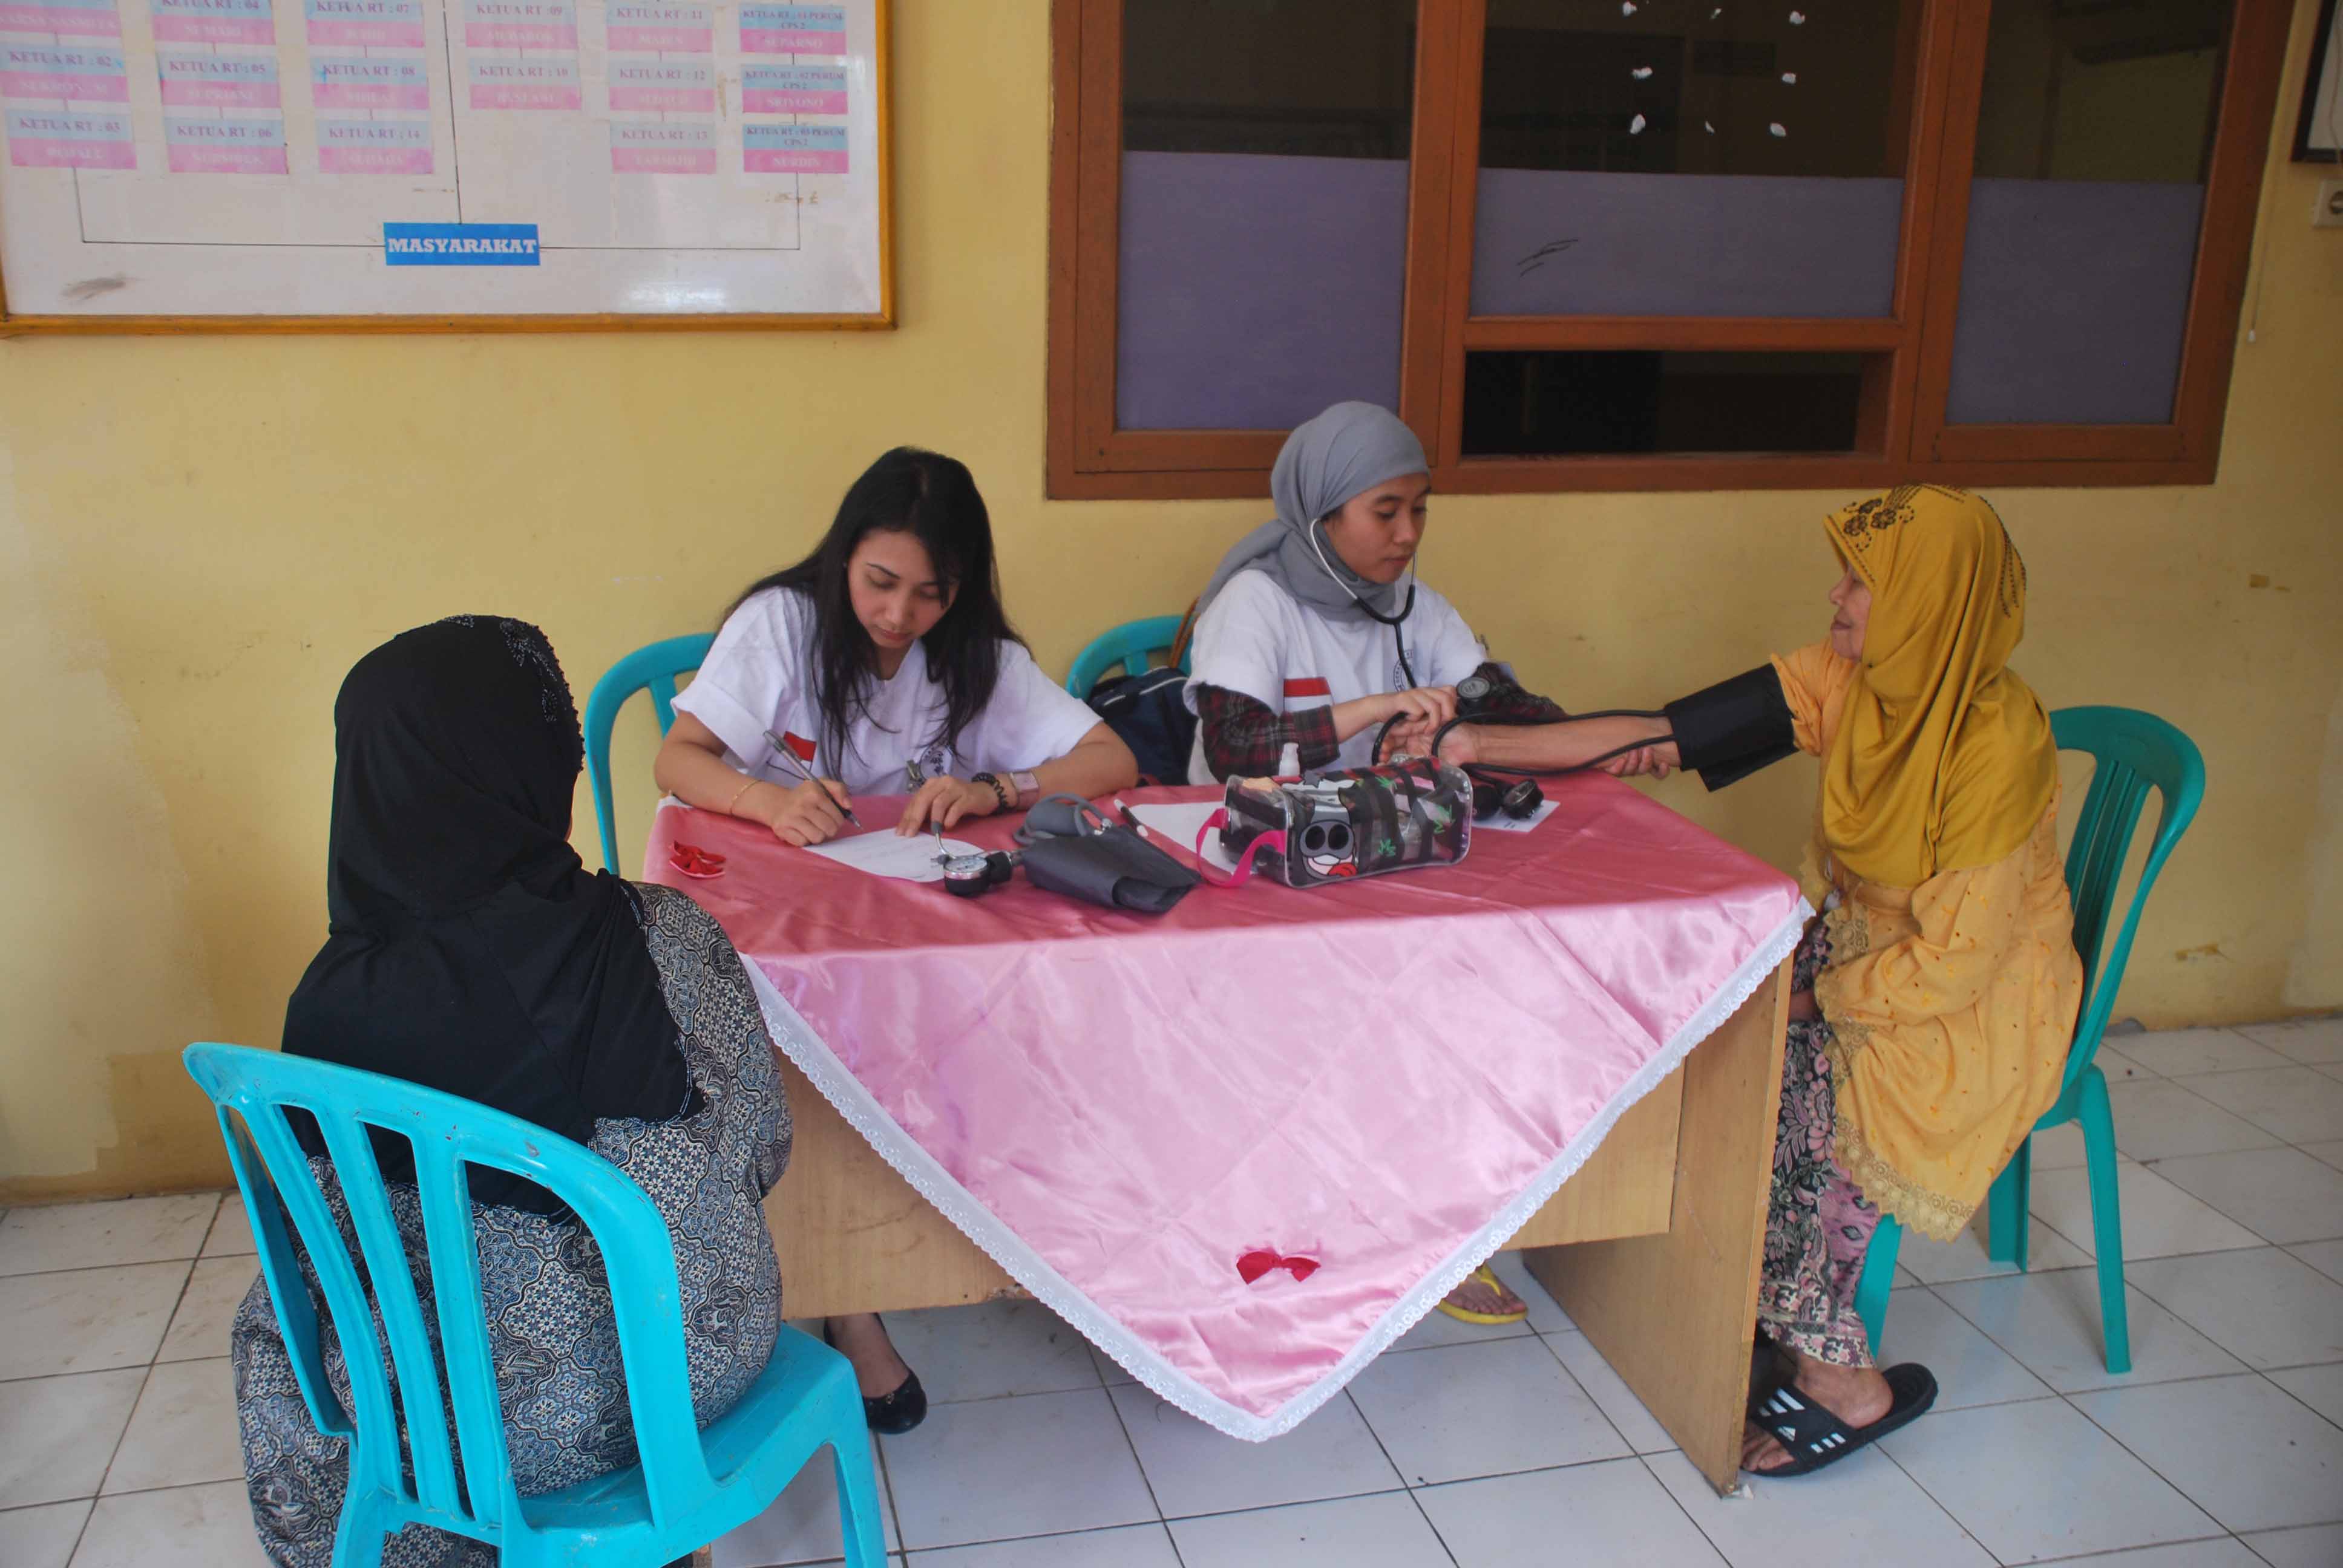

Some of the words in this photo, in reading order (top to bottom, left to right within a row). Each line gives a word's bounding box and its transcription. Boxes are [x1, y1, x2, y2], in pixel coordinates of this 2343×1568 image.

[316, 1, 364, 13] KETUA
[368, 2, 384, 13] RT
[476, 4, 522, 15] KETUA
[525, 5, 543, 15] RT
[616, 7, 661, 19] KETUA
[664, 10, 680, 20] RT
[743, 10, 775, 19] KETUA
[9, 51, 63, 65] KETUA
[65, 54, 83, 65] RT
[169, 60, 218, 73] KETUA
[222, 62, 241, 73] RT
[323, 64, 370, 76] KETUA
[373, 65, 390, 76] RT
[479, 65, 525, 77] KETUA
[528, 67, 543, 77] RT
[619, 68, 664, 79] KETUA
[666, 69, 682, 80] RT
[746, 71, 778, 79] KETUA
[19, 118, 71, 131] KETUA
[74, 120, 91, 131] RT
[177, 125, 225, 137] KETUA
[229, 127, 247, 137] RT
[258, 127, 272, 137] 06
[329, 128, 375, 139] KETUA
[378, 128, 396, 139] RT
[622, 129, 666, 140] KETUA
[669, 130, 684, 140] RT
[746, 126, 779, 136] KETUA
[388, 238, 537, 253] MASYARAKAT
